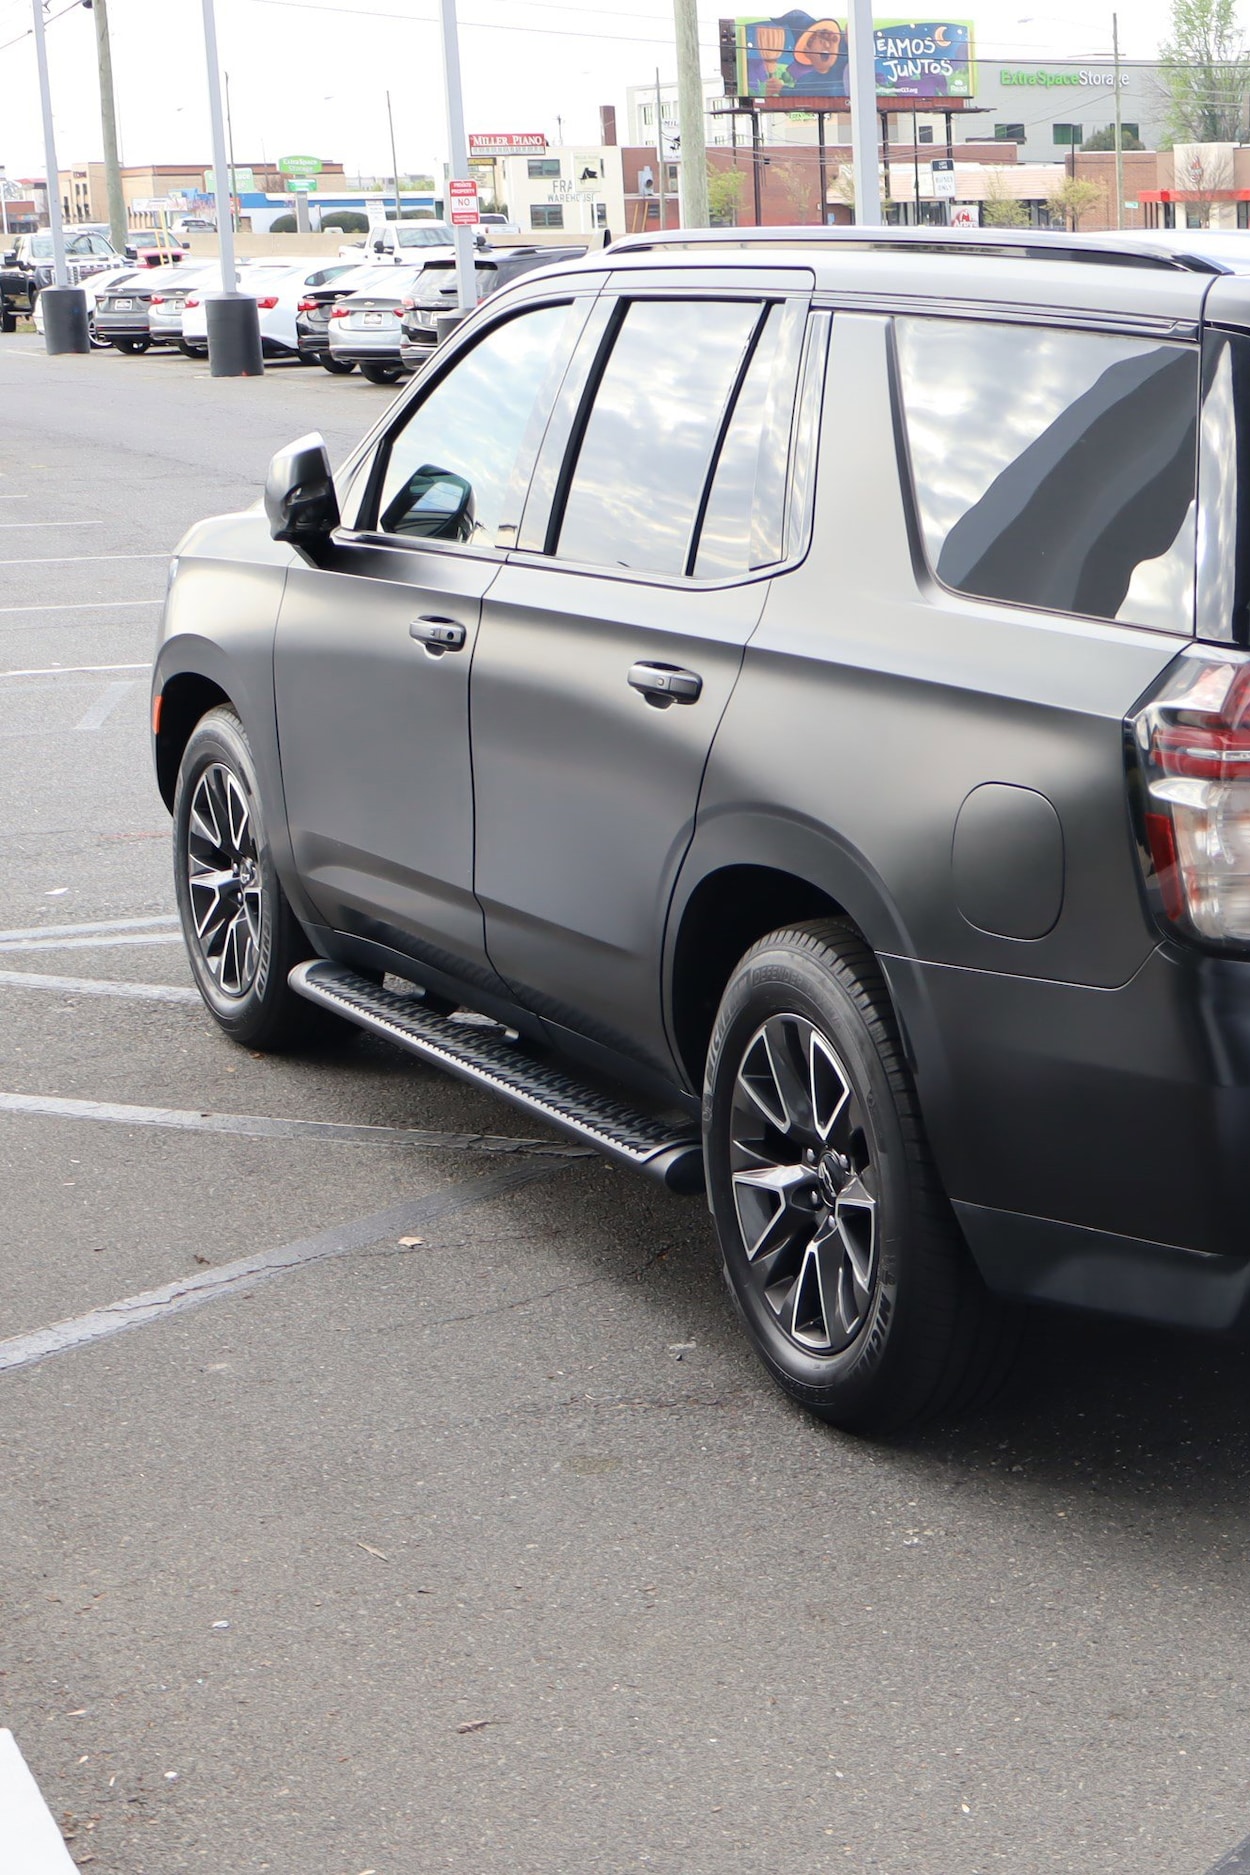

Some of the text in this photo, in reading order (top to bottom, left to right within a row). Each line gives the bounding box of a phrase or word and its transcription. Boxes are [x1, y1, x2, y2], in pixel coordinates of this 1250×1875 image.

[473, 135, 543, 146] MILLER PIANO
[458, 198, 470, 206] NO
